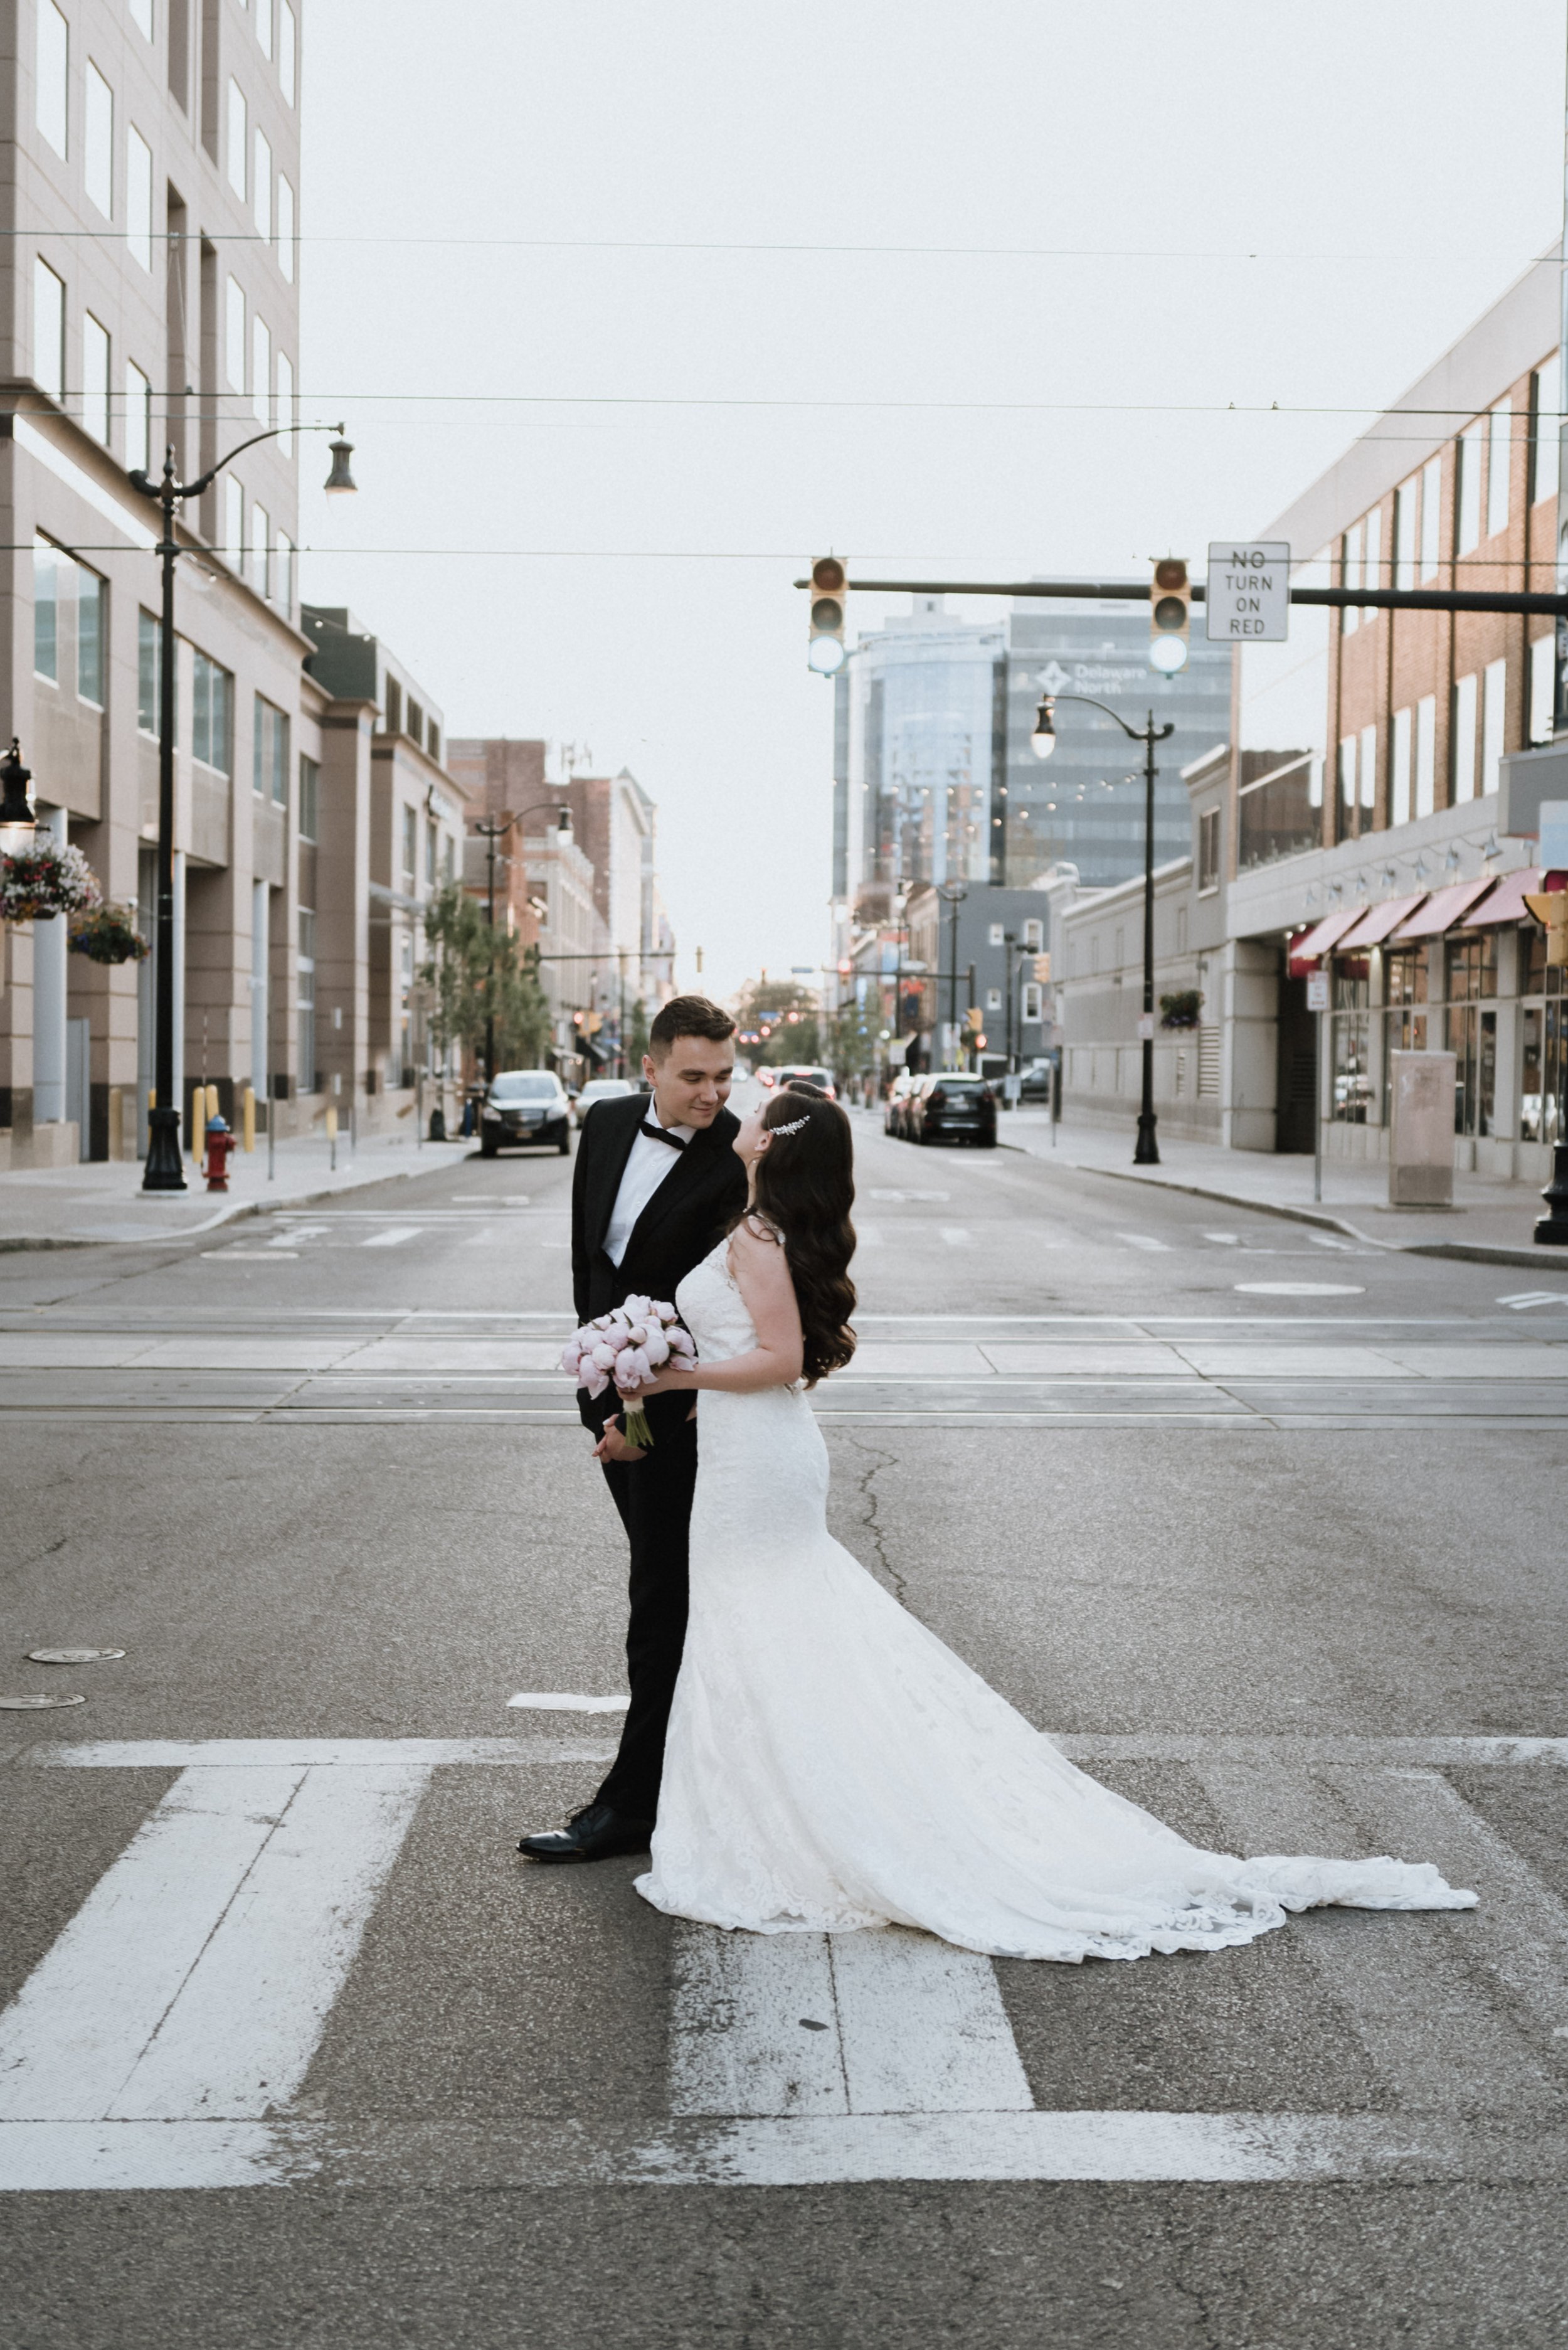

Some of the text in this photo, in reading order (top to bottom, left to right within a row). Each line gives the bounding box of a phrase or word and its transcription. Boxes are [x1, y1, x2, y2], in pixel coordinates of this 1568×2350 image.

[1232, 551, 1266, 568] NO
[1226, 576, 1273, 590] TURN
[1236, 598, 1260, 612] ON
[1230, 619, 1264, 634] RED
[1075, 663, 1147, 679] Delaware
[1075, 680, 1121, 694] North
